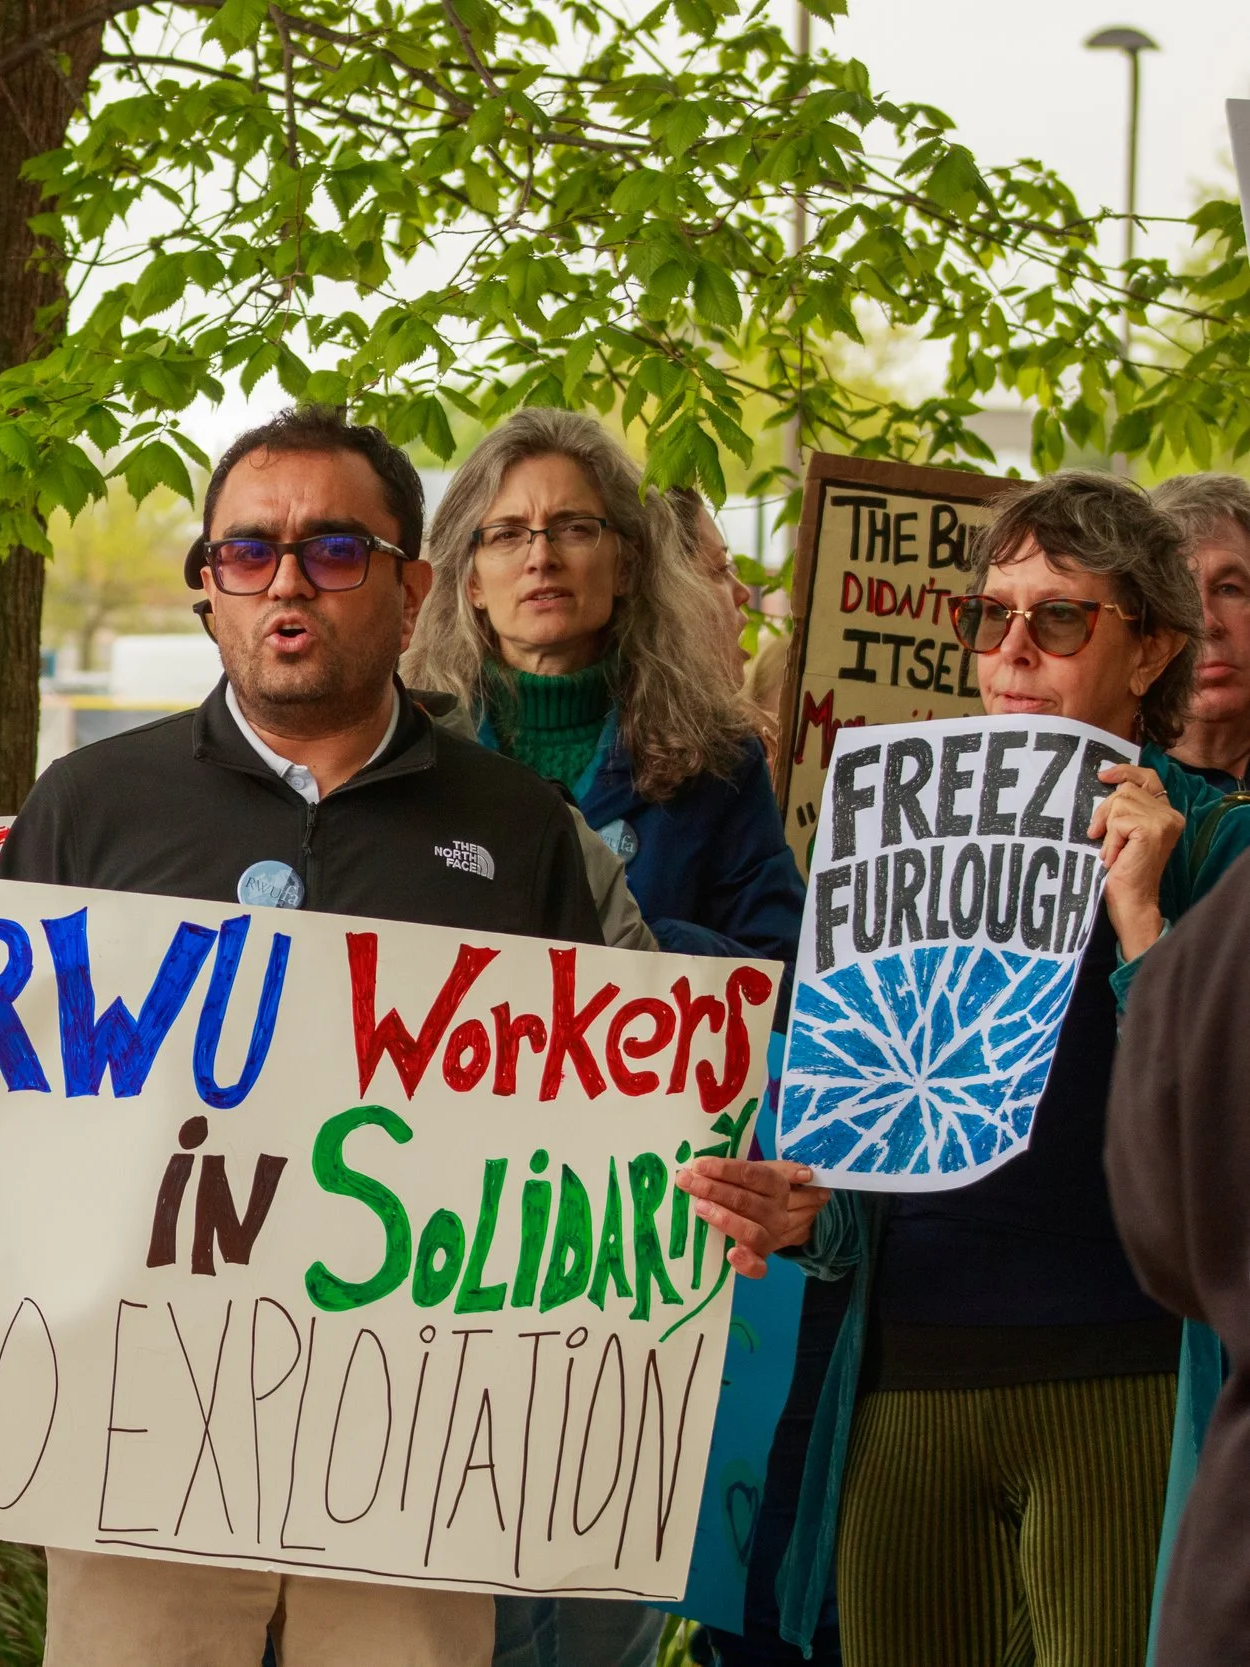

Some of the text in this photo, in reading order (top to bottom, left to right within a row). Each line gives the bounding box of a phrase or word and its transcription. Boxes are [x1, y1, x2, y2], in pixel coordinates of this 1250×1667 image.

[830, 495, 918, 565] THE
[839, 571, 952, 626] DIDN'T
[838, 629, 981, 698] ITSEL
[831, 731, 1131, 861] FREEZE
[434, 845, 477, 863] NORTH
[446, 857, 477, 873] FACE
[452, 840, 477, 854] THE
